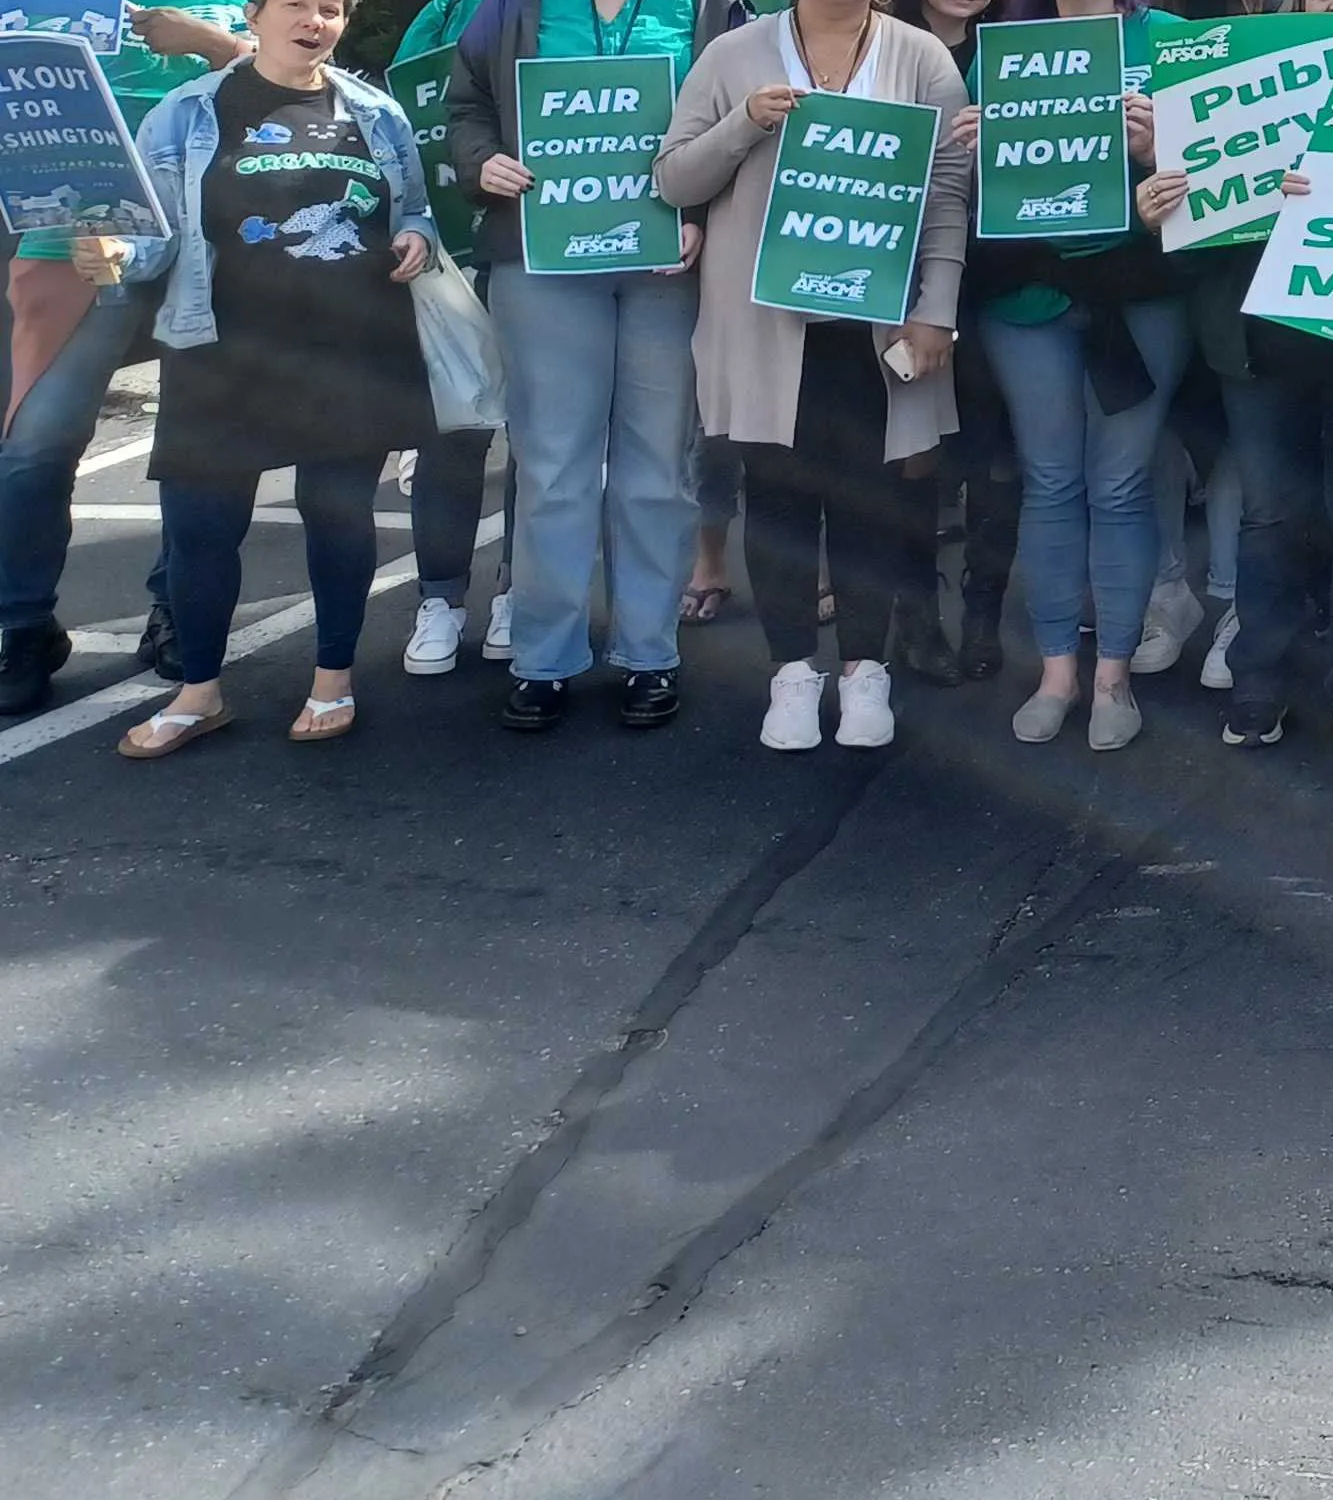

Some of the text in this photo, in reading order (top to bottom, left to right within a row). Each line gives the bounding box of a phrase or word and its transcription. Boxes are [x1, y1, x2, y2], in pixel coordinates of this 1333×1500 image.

[998, 50, 1091, 79] FAIR
[1156, 43, 1230, 65] AFSCME
[0, 66, 90, 92] LKOUT
[6, 100, 62, 119] FOR
[540, 87, 640, 117] FAIR
[984, 96, 1119, 120] CONTRACT
[0, 128, 120, 149] SHINGTON
[526, 134, 668, 157] CONTRACT
[801, 123, 902, 160] FAIR
[995, 135, 1112, 168] NOW!
[540, 174, 662, 205] NOW!
[779, 168, 923, 204] CONTRACT
[1016, 200, 1088, 219] AFSCME
[779, 210, 905, 250] NOW!
[564, 238, 641, 256] AFSCME
[791, 276, 866, 299] AFSCME
